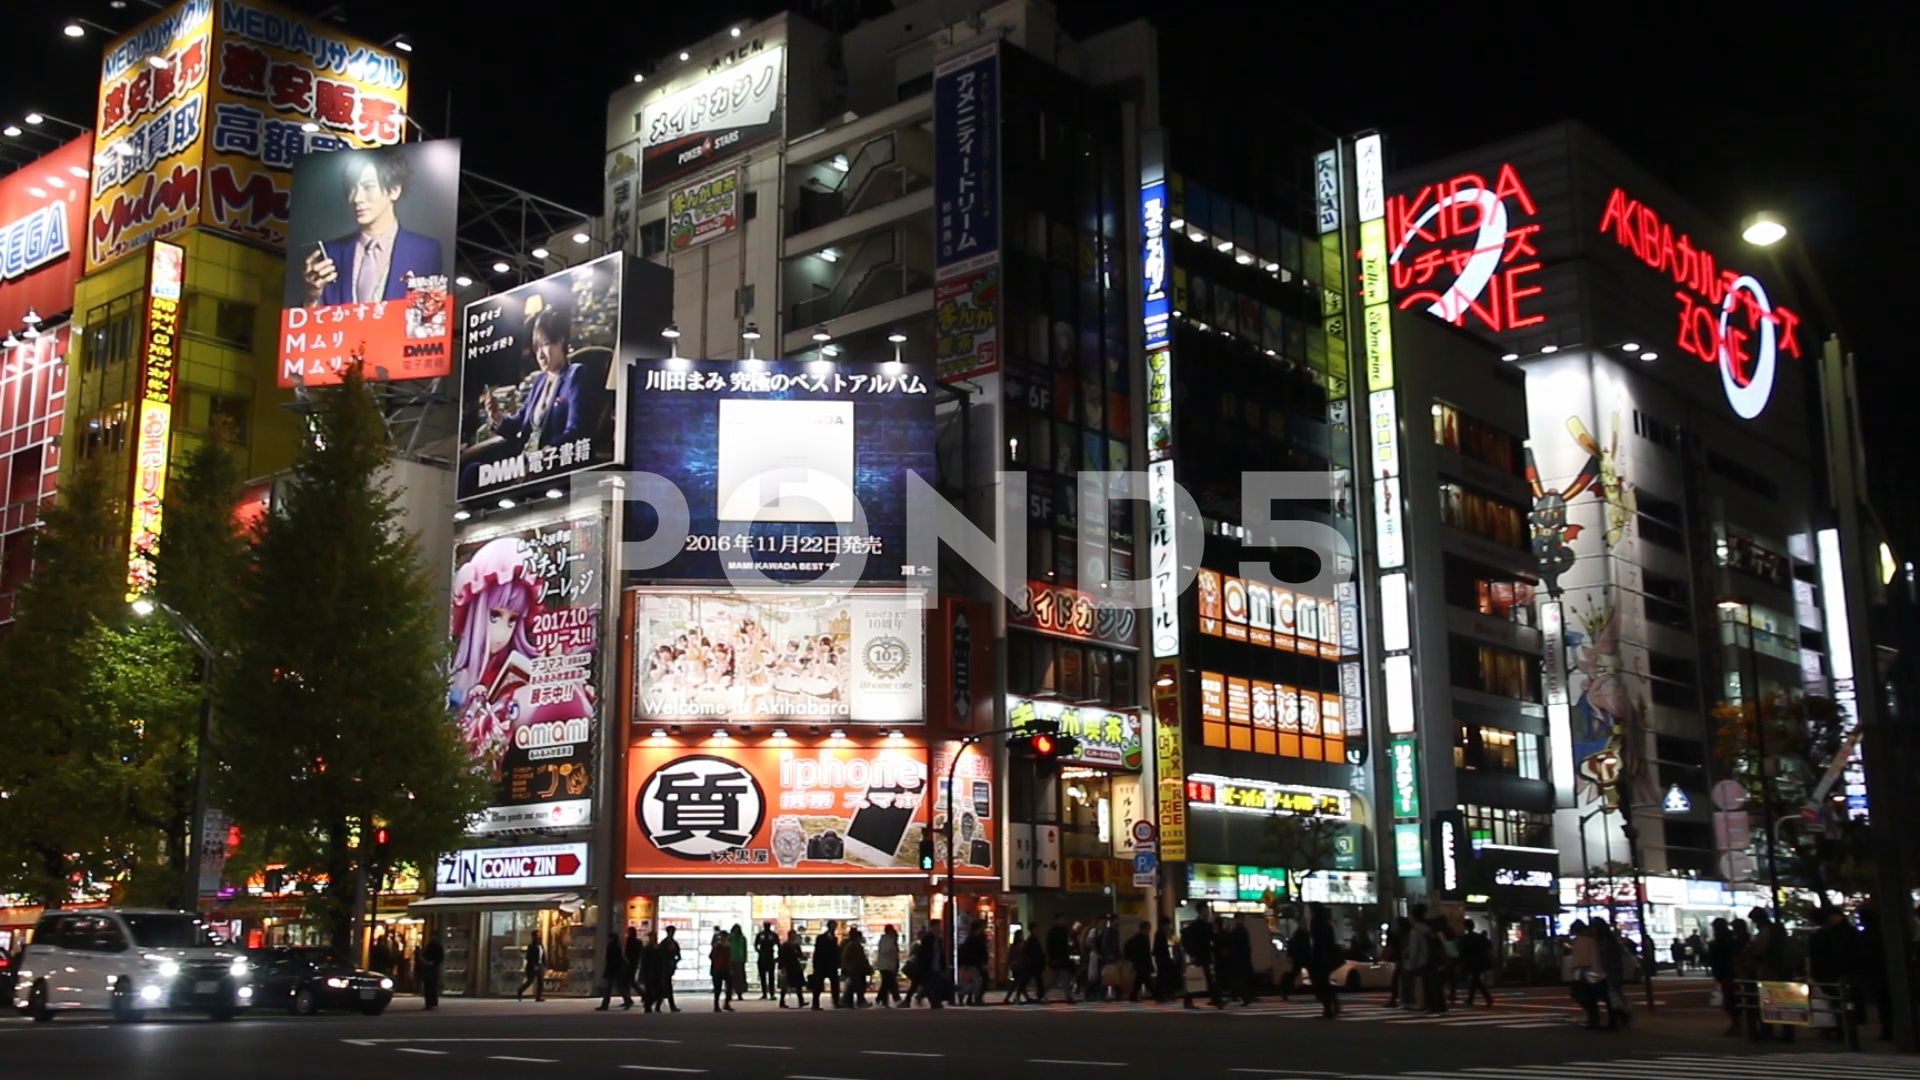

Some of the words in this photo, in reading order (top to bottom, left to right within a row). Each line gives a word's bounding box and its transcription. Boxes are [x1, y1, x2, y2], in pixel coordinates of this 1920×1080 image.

[222, 3, 404, 88] MEDIAリサイクル
[222, 43, 397, 141] 激安販売
[651, 66, 773, 144] メイドカジノ
[679, 146, 703, 164] POKER
[714, 131, 739, 149] STARS
[288, 307, 307, 329] D
[313, 301, 389, 323] でかすぎ
[286, 333, 306, 354] M
[310, 331, 344, 349] ムリ
[403, 343, 444, 358] DMM
[284, 357, 304, 378] M
[645, 370, 726, 392] 川田まみ
[729, 370, 928, 394] 究極のベストアルバム
[1029, 384, 1050, 410] 6F
[478, 455, 525, 486] DMM
[528, 438, 592, 473] 電子書籍
[685, 533, 882, 555] 2016年11月22日発売
[728, 562, 754, 570] MAMI
[755, 562, 797, 571] KAWADA
[799, 562, 823, 571] BEST
[533, 608, 588, 633] 2017.10
[537, 627, 592, 650] リリース!!
[644, 700, 725, 715] Welcome
[758, 698, 849, 715] Akihabara
[516, 721, 588, 748] amiami
[1171, 734, 1181, 771] TAX
[781, 753, 920, 788] iphone
[653, 772, 748, 848] 質
[843, 792, 921, 809] スマホ
[482, 858, 531, 877] COMIC
[533, 856, 556, 876] ZIN
[718, 848, 768, 864] 大黒屋
